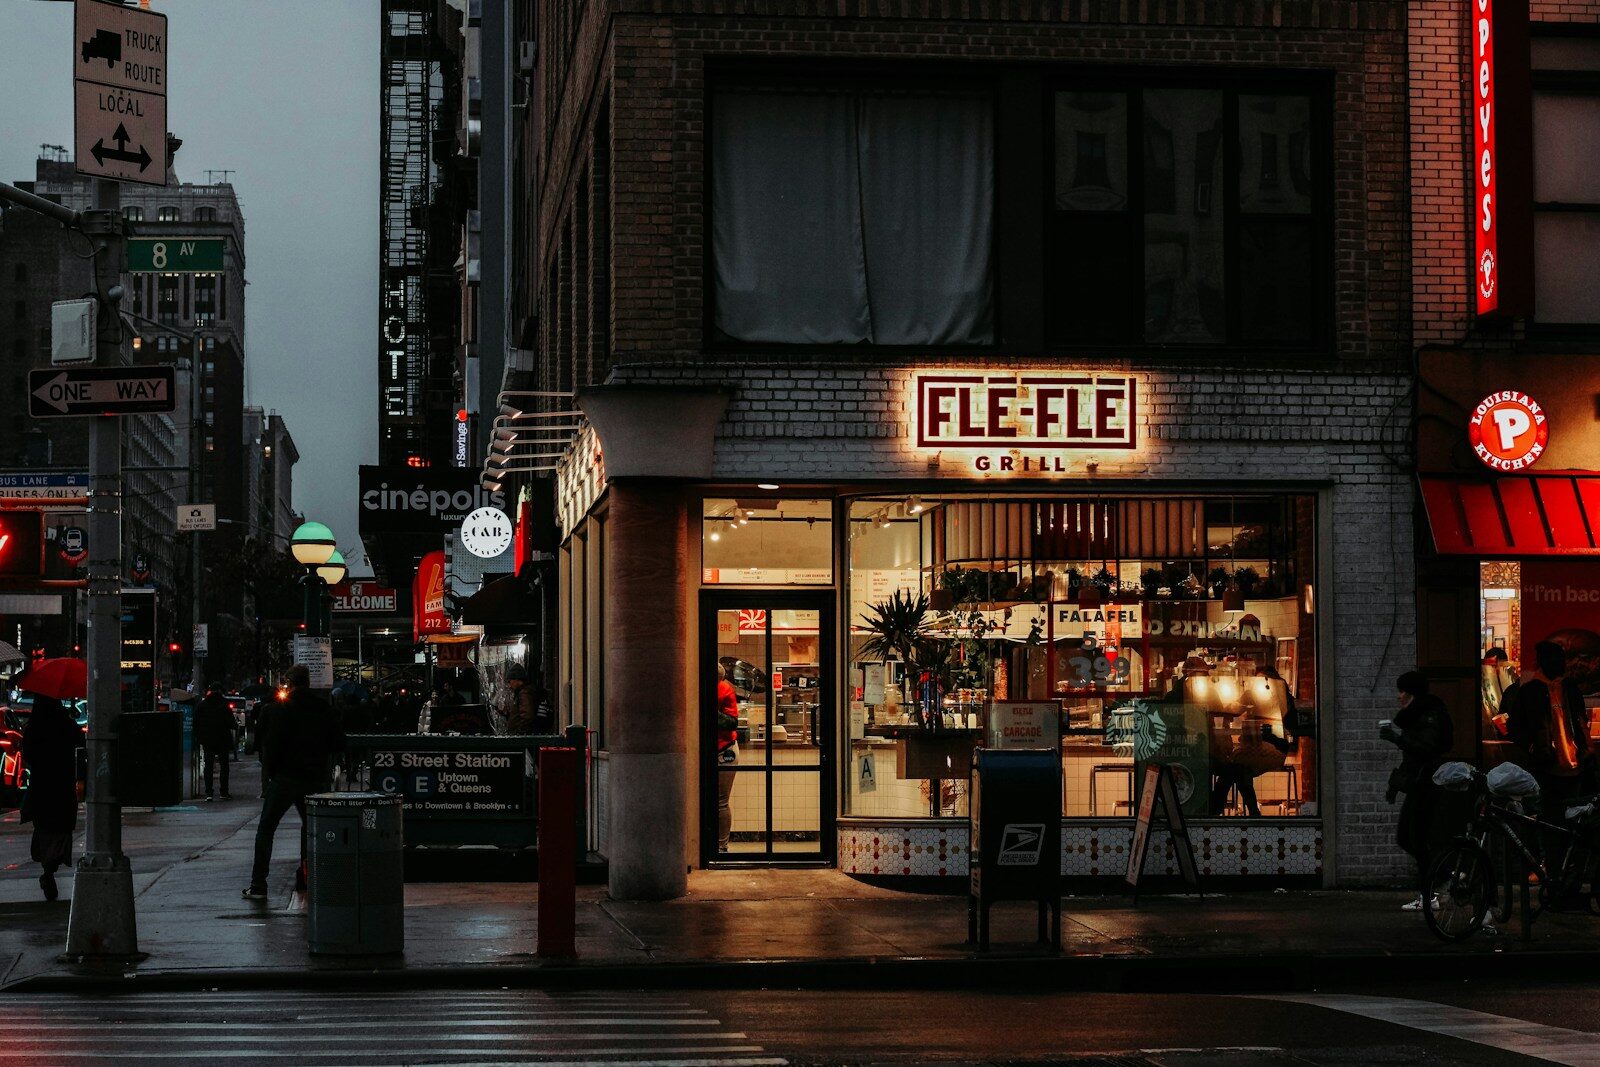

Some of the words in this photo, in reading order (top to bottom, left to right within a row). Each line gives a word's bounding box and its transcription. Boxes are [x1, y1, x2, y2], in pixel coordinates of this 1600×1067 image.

[125, 29, 162, 53] TRUCK
[125, 62, 162, 85] ROUTE
[99, 92, 144, 117] LOCAL
[152, 242, 168, 268] 8
[179, 242, 196, 256] AV
[49, 383, 92, 401] ONE
[116, 380, 162, 400] WAY
[1471, 390, 1545, 426] LOUISIANA
[1493, 408, 1531, 450] P
[975, 456, 1066, 472] GRILL
[1474, 441, 1544, 470] KITCHEN
[22, 476, 49, 486] LANE
[362, 482, 507, 517] cinépolis
[333, 594, 395, 610] ELCOME
[425, 618, 441, 628] 212
[1059, 609, 1139, 623] FALAFEL
[1081, 630, 1098, 651] 5
[374, 753, 395, 768] 23
[400, 752, 450, 768] Street
[454, 752, 511, 768] Station
[861, 758, 872, 779] A
[381, 776, 397, 793] C
[415, 776, 429, 793] E
[437, 772, 479, 784] Uptown
[437, 783, 447, 793] &
[450, 783, 492, 794] Queens
[415, 802, 423, 810] to
[425, 802, 463, 810] Downtown
[473, 802, 506, 811] Brooklyn
